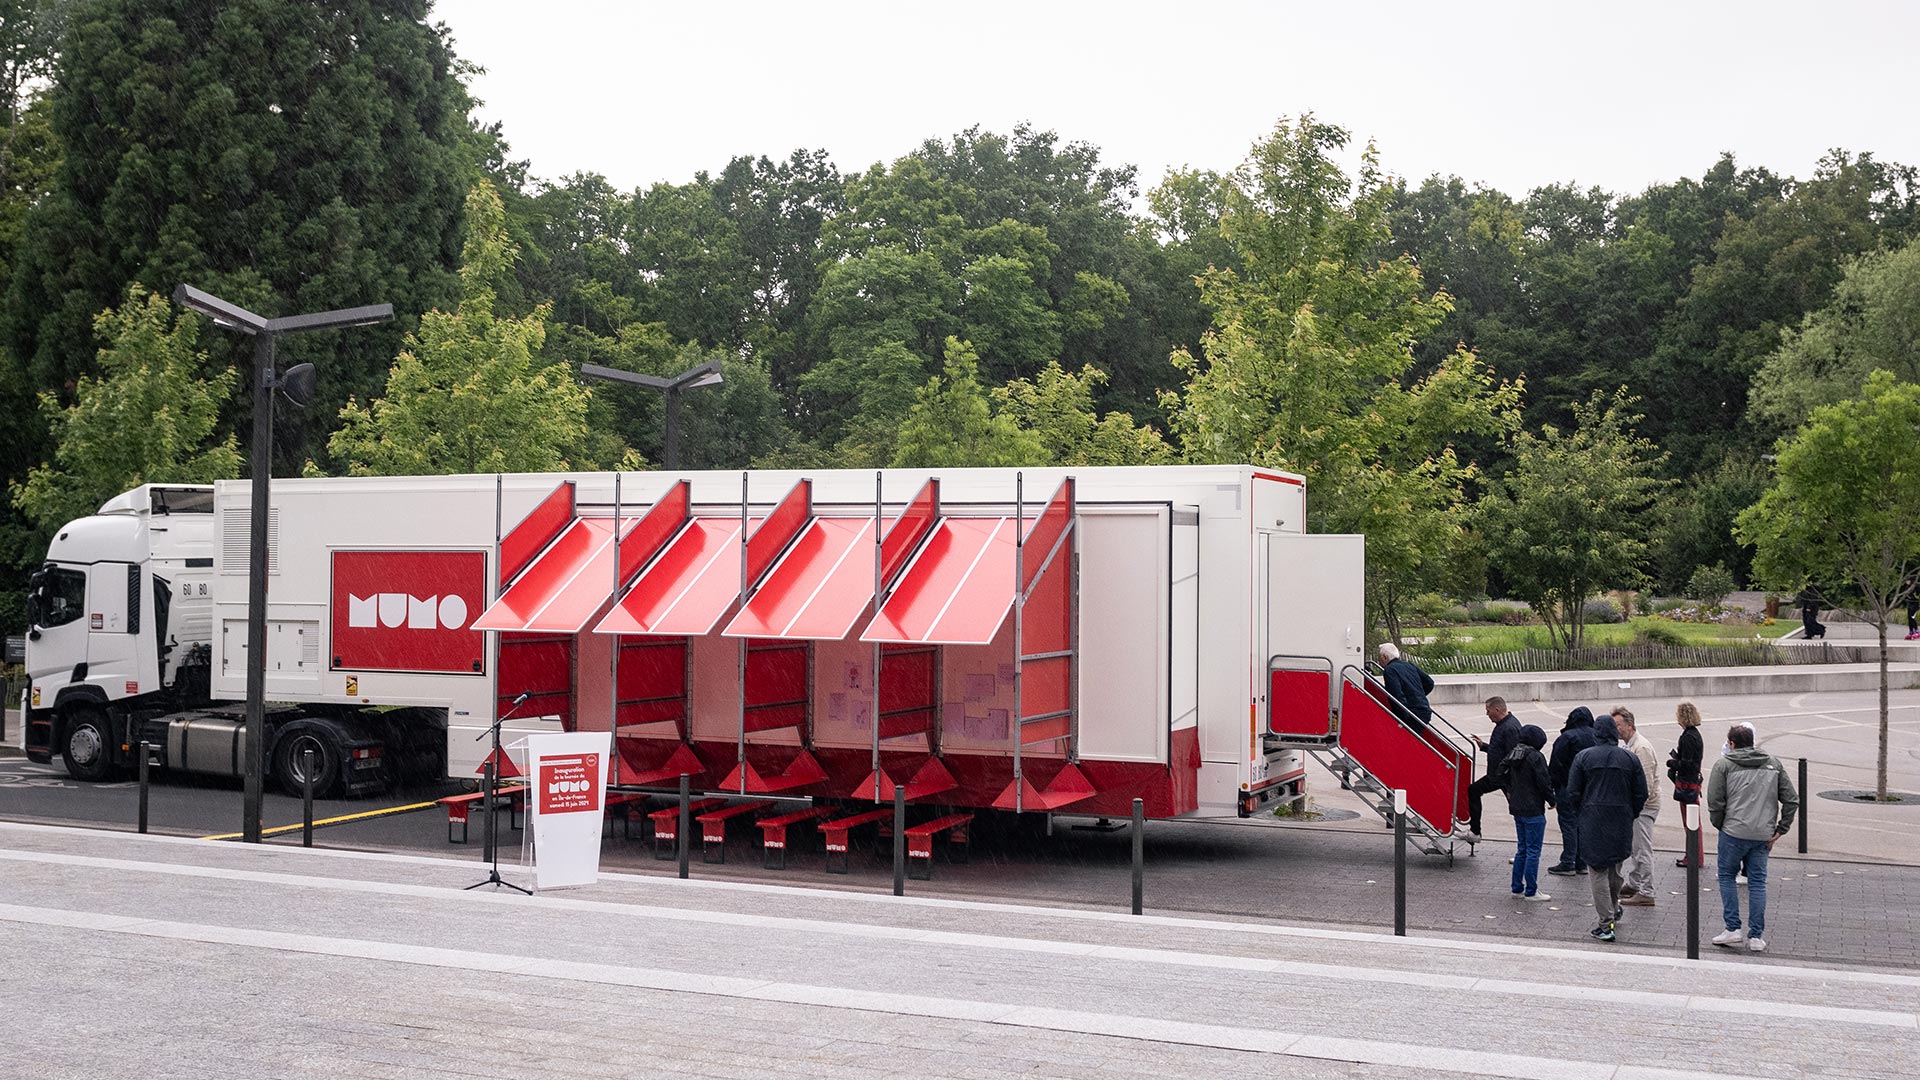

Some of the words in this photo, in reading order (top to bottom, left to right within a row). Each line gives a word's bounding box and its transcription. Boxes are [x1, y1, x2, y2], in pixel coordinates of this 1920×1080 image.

[183, 583, 192, 596] 60
[199, 583, 208, 596] 80
[349, 592, 468, 630] MUMO
[554, 767, 585, 775] Inauguration
[549, 780, 590, 794] MUMO
